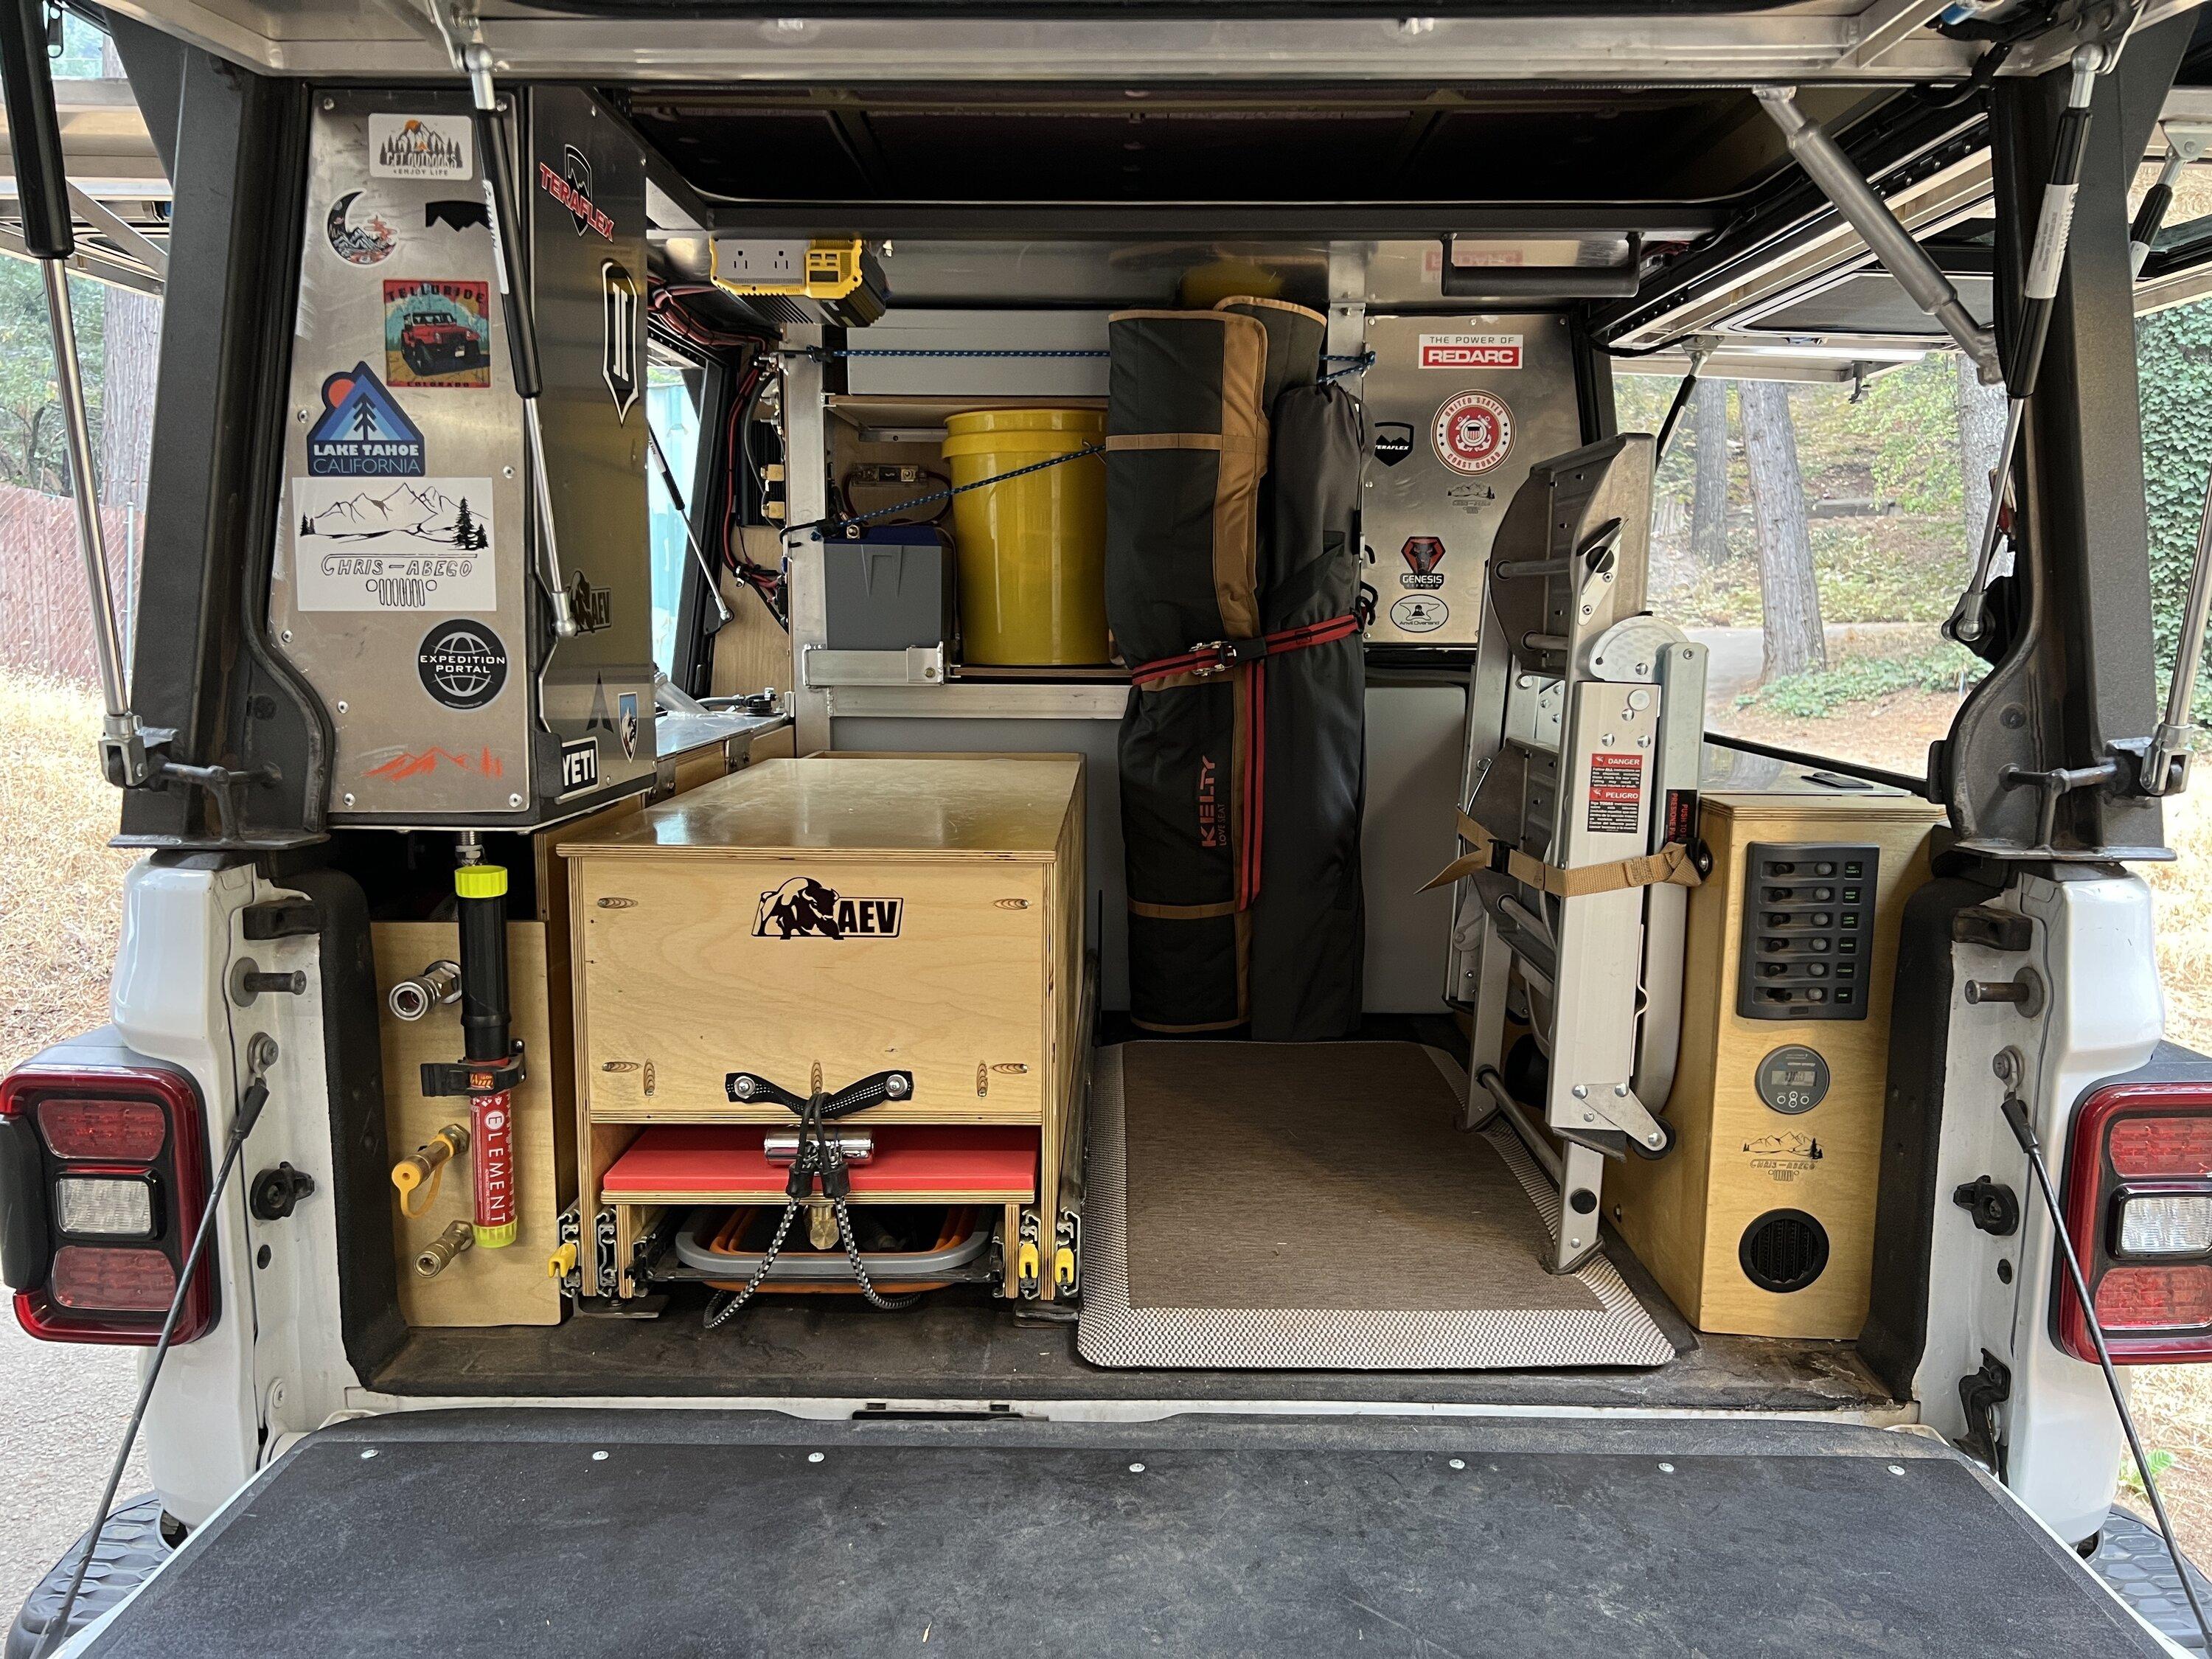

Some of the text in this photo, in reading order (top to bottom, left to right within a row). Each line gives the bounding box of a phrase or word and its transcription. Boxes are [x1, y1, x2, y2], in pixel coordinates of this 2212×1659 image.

[386, 152, 457, 168] GET OUTDOORS
[540, 161, 615, 243] TERAFLEX
[386, 283, 484, 304] TELLURIDE
[1430, 336, 1514, 344] THE POWER OF
[1428, 349, 1514, 364] REDARC
[1445, 397, 1503, 417] UNITED STATES
[313, 444, 420, 456] LAKE TAHOE
[313, 458, 421, 474] CALIFORNIA
[1447, 451, 1501, 470] COAST GUARD
[1402, 574, 1443, 584] GENESIS
[420, 655, 506, 664] EXPEDITION
[436, 664, 491, 673] PORTAL
[563, 748, 595, 787] YETI
[1200, 754, 1216, 847] KELTY
[1669, 793, 1678, 827] PRESIONE
[1680, 804, 1688, 822] PUSH
[1217, 803, 1227, 846] LOVE SEAT
[1680, 824, 1687, 833] TO
[838, 900, 898, 933] AEV
[487, 1113, 507, 1223] ELEMENT
